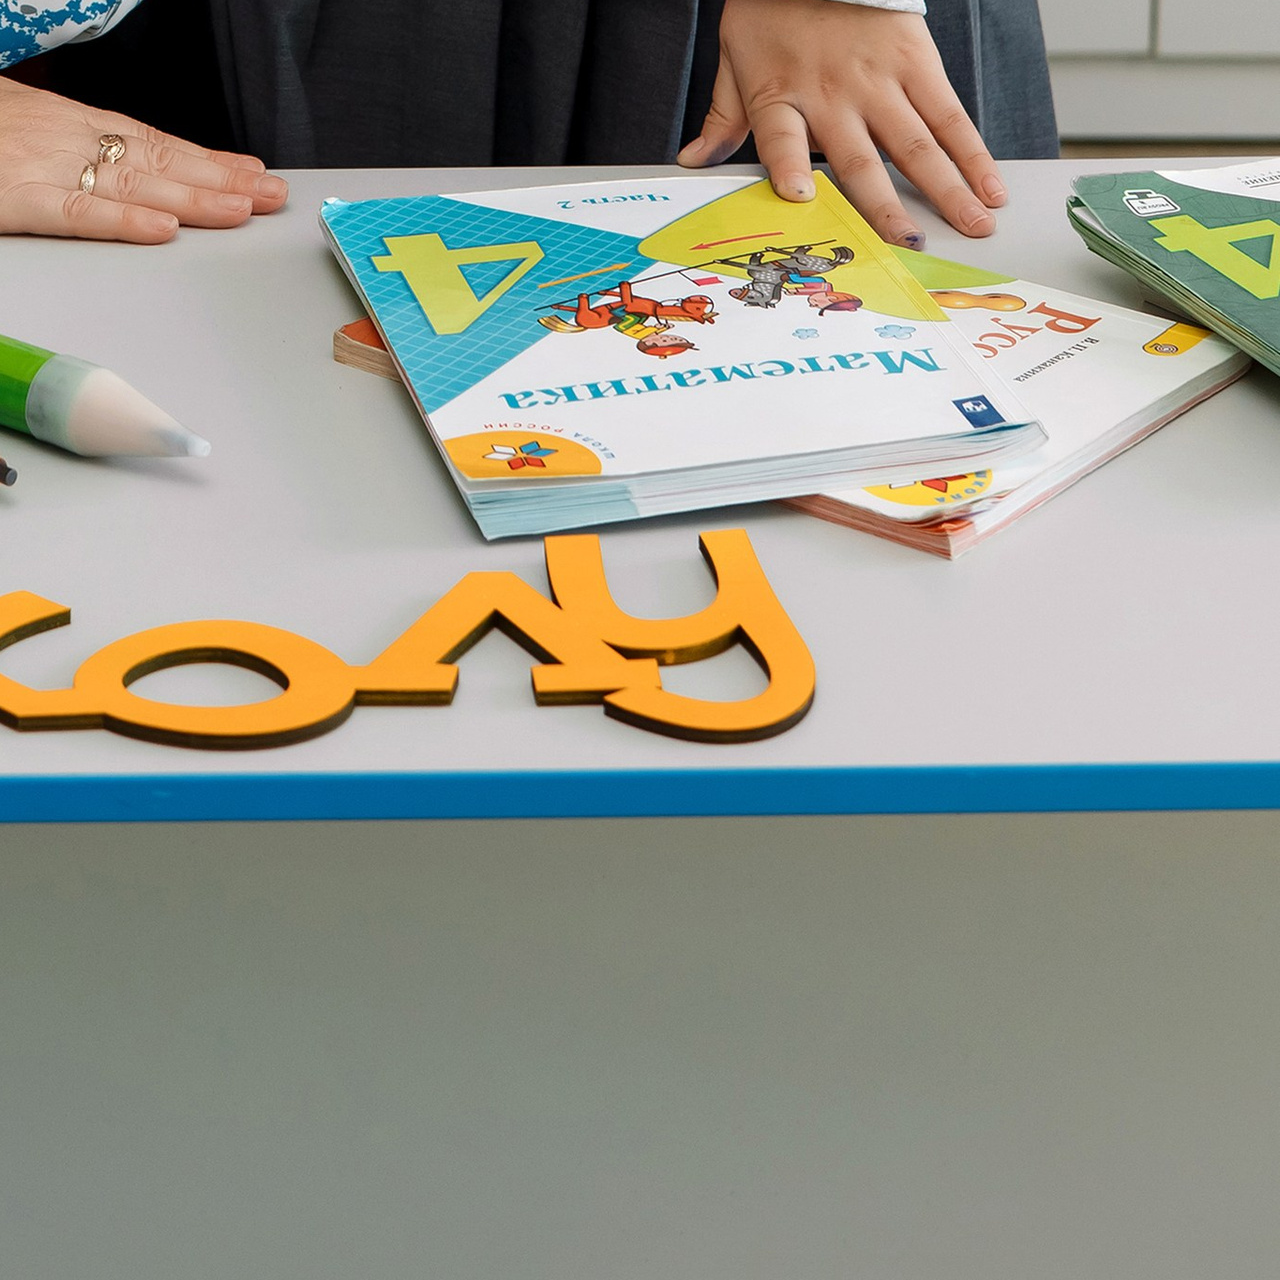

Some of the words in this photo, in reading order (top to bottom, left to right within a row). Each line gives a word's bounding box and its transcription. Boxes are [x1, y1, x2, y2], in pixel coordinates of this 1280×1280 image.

[557, 199, 575, 209] 2
[581, 193, 671, 206] Часть
[1147, 214, 1280, 300] 4
[370, 232, 546, 336] 4
[497, 347, 947, 410] Математика
[482, 422, 564, 433] РОССИИ
[573, 431, 616, 460] ШКОЛА
